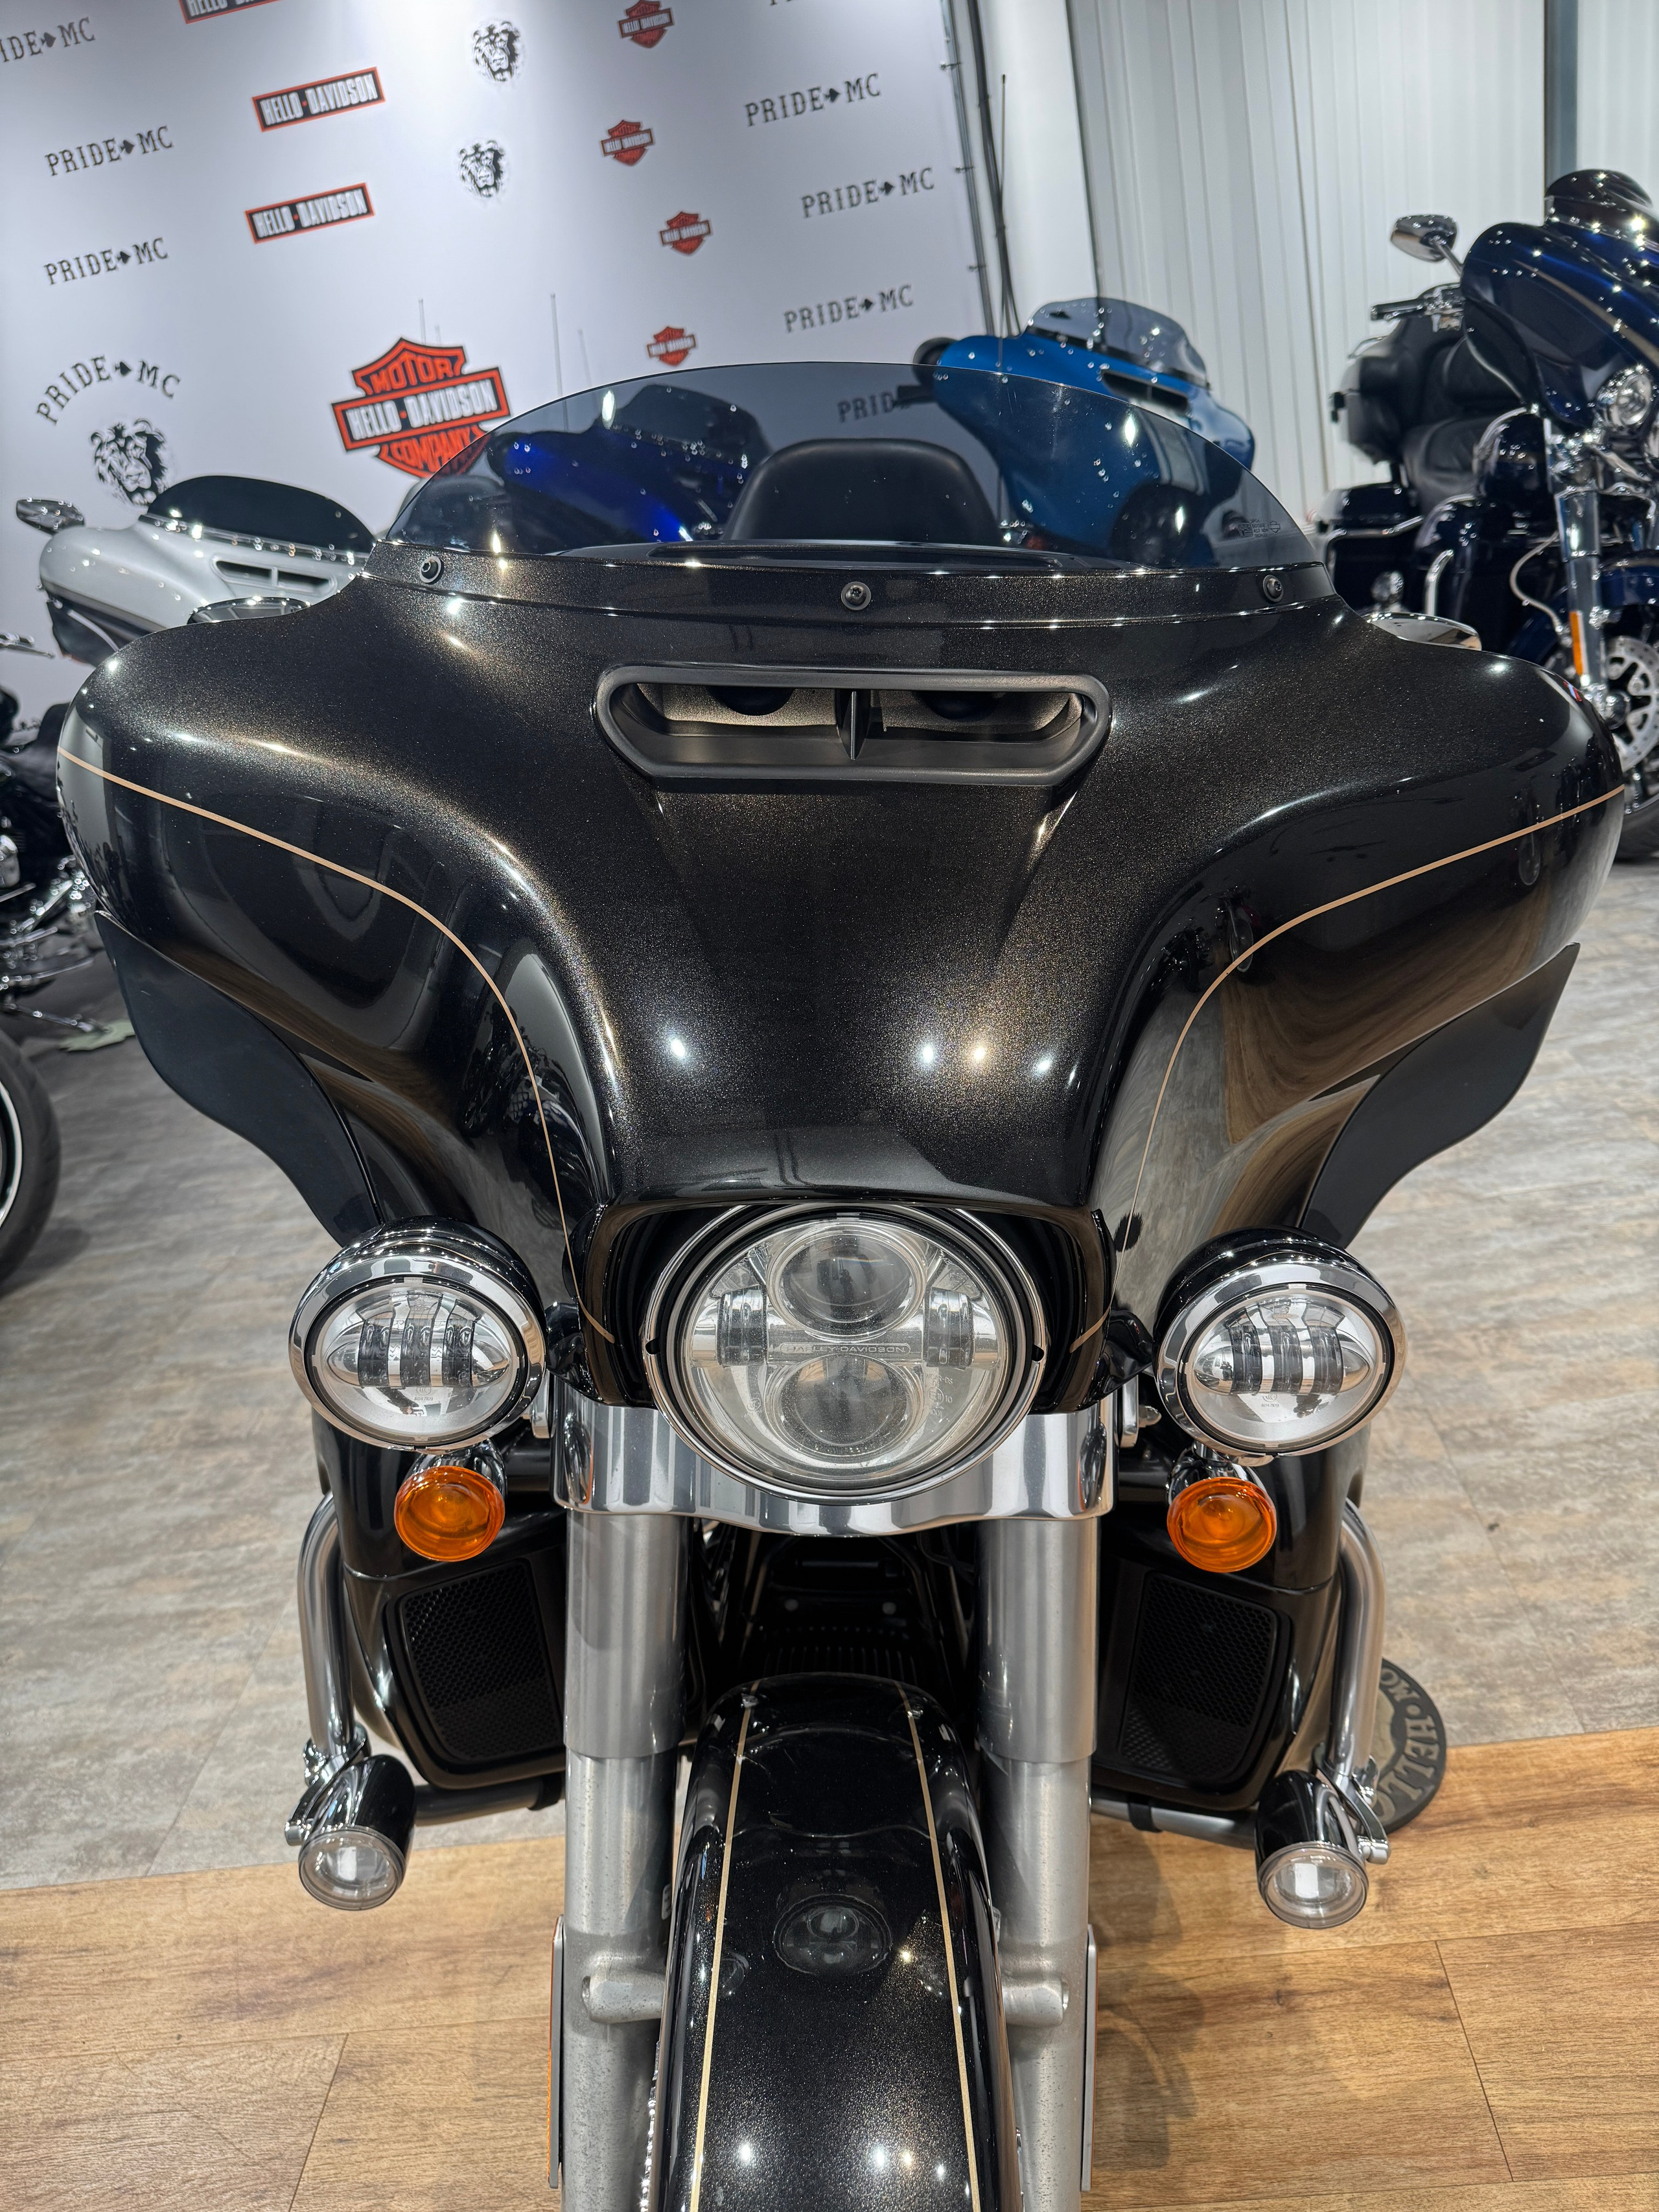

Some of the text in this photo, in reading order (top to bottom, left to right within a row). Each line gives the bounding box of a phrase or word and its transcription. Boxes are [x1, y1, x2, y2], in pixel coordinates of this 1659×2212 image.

[57, 16, 96, 47] MC
[260, 73, 378, 126] HELLO DAVIDSON
[745, 73, 881, 127] PRIDE MC
[45, 124, 174, 176] PRIDE MC
[252, 189, 368, 239] HELLO DAVIDSON
[801, 166, 935, 218] PRIDE MC
[43, 237, 168, 285] PRIDE MC
[783, 283, 914, 333] PRIDE MC
[36, 355, 181, 425] PRIDE MC
[369, 351, 455, 394] MOTOR
[345, 378, 498, 441] HELLO DAVIDSON
[837, 391, 910, 423] PRID
[389, 425, 472, 474] COMPANY
[785, 1345, 906, 1353] HARLEY-DAVIDSON
